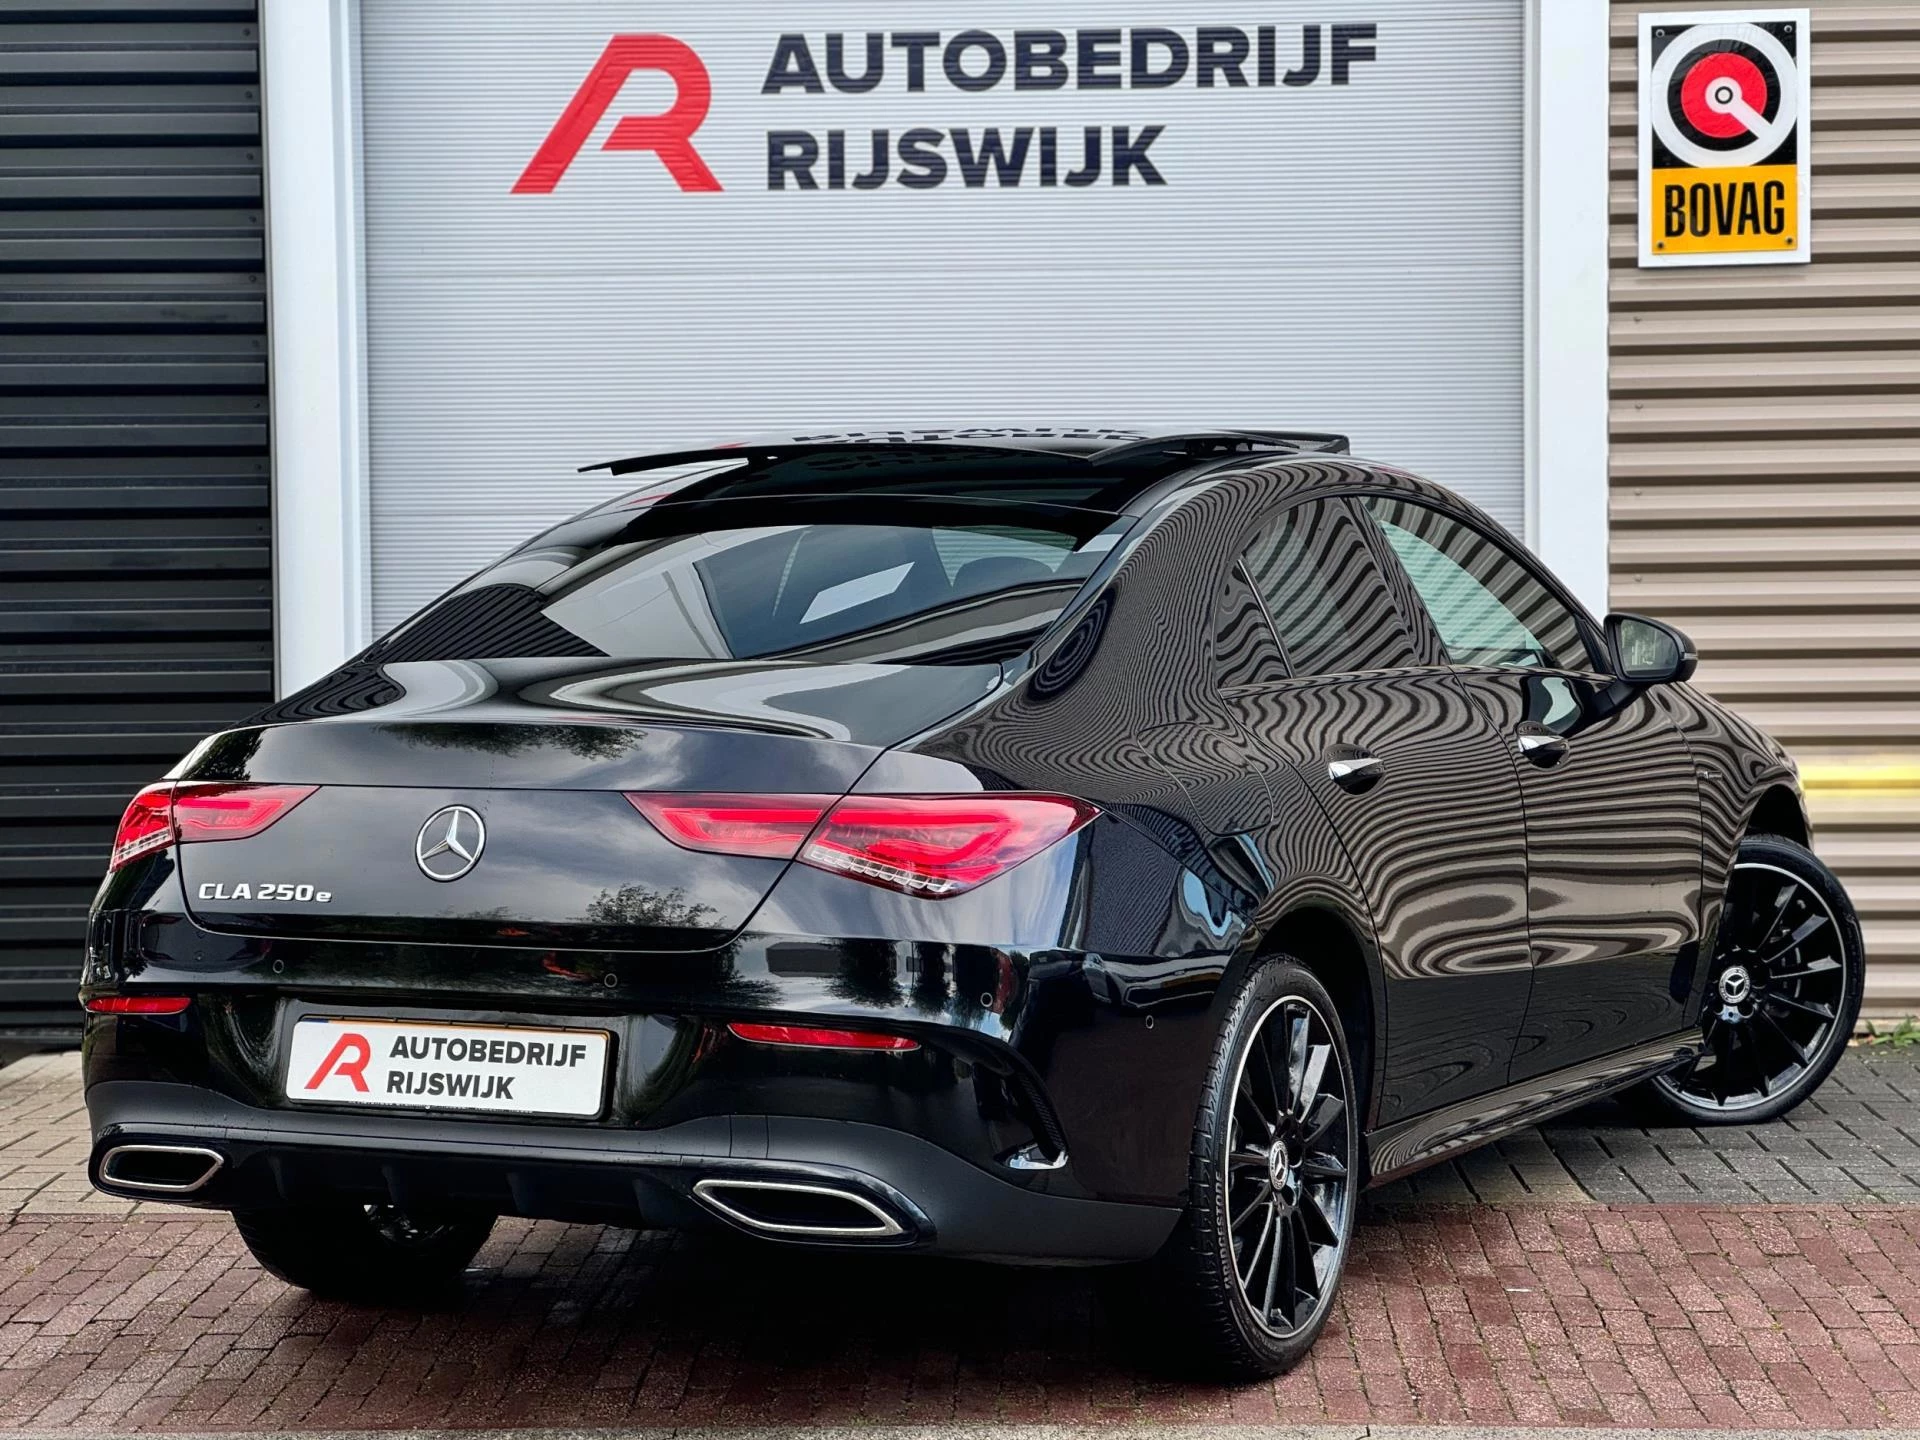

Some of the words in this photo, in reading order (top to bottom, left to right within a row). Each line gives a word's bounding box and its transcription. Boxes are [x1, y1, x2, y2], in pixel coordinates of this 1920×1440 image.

[762, 23, 1378, 95] AUTOBEDRIJF
[768, 125, 1167, 191] RIJSWIJK
[1664, 180, 1785, 237] BOVAG
[198, 883, 252, 900] CLA
[257, 883, 333, 902] 250e
[389, 1035, 587, 1068] AUTOBEDRIJF
[386, 1070, 514, 1100] RIJSWIJK
